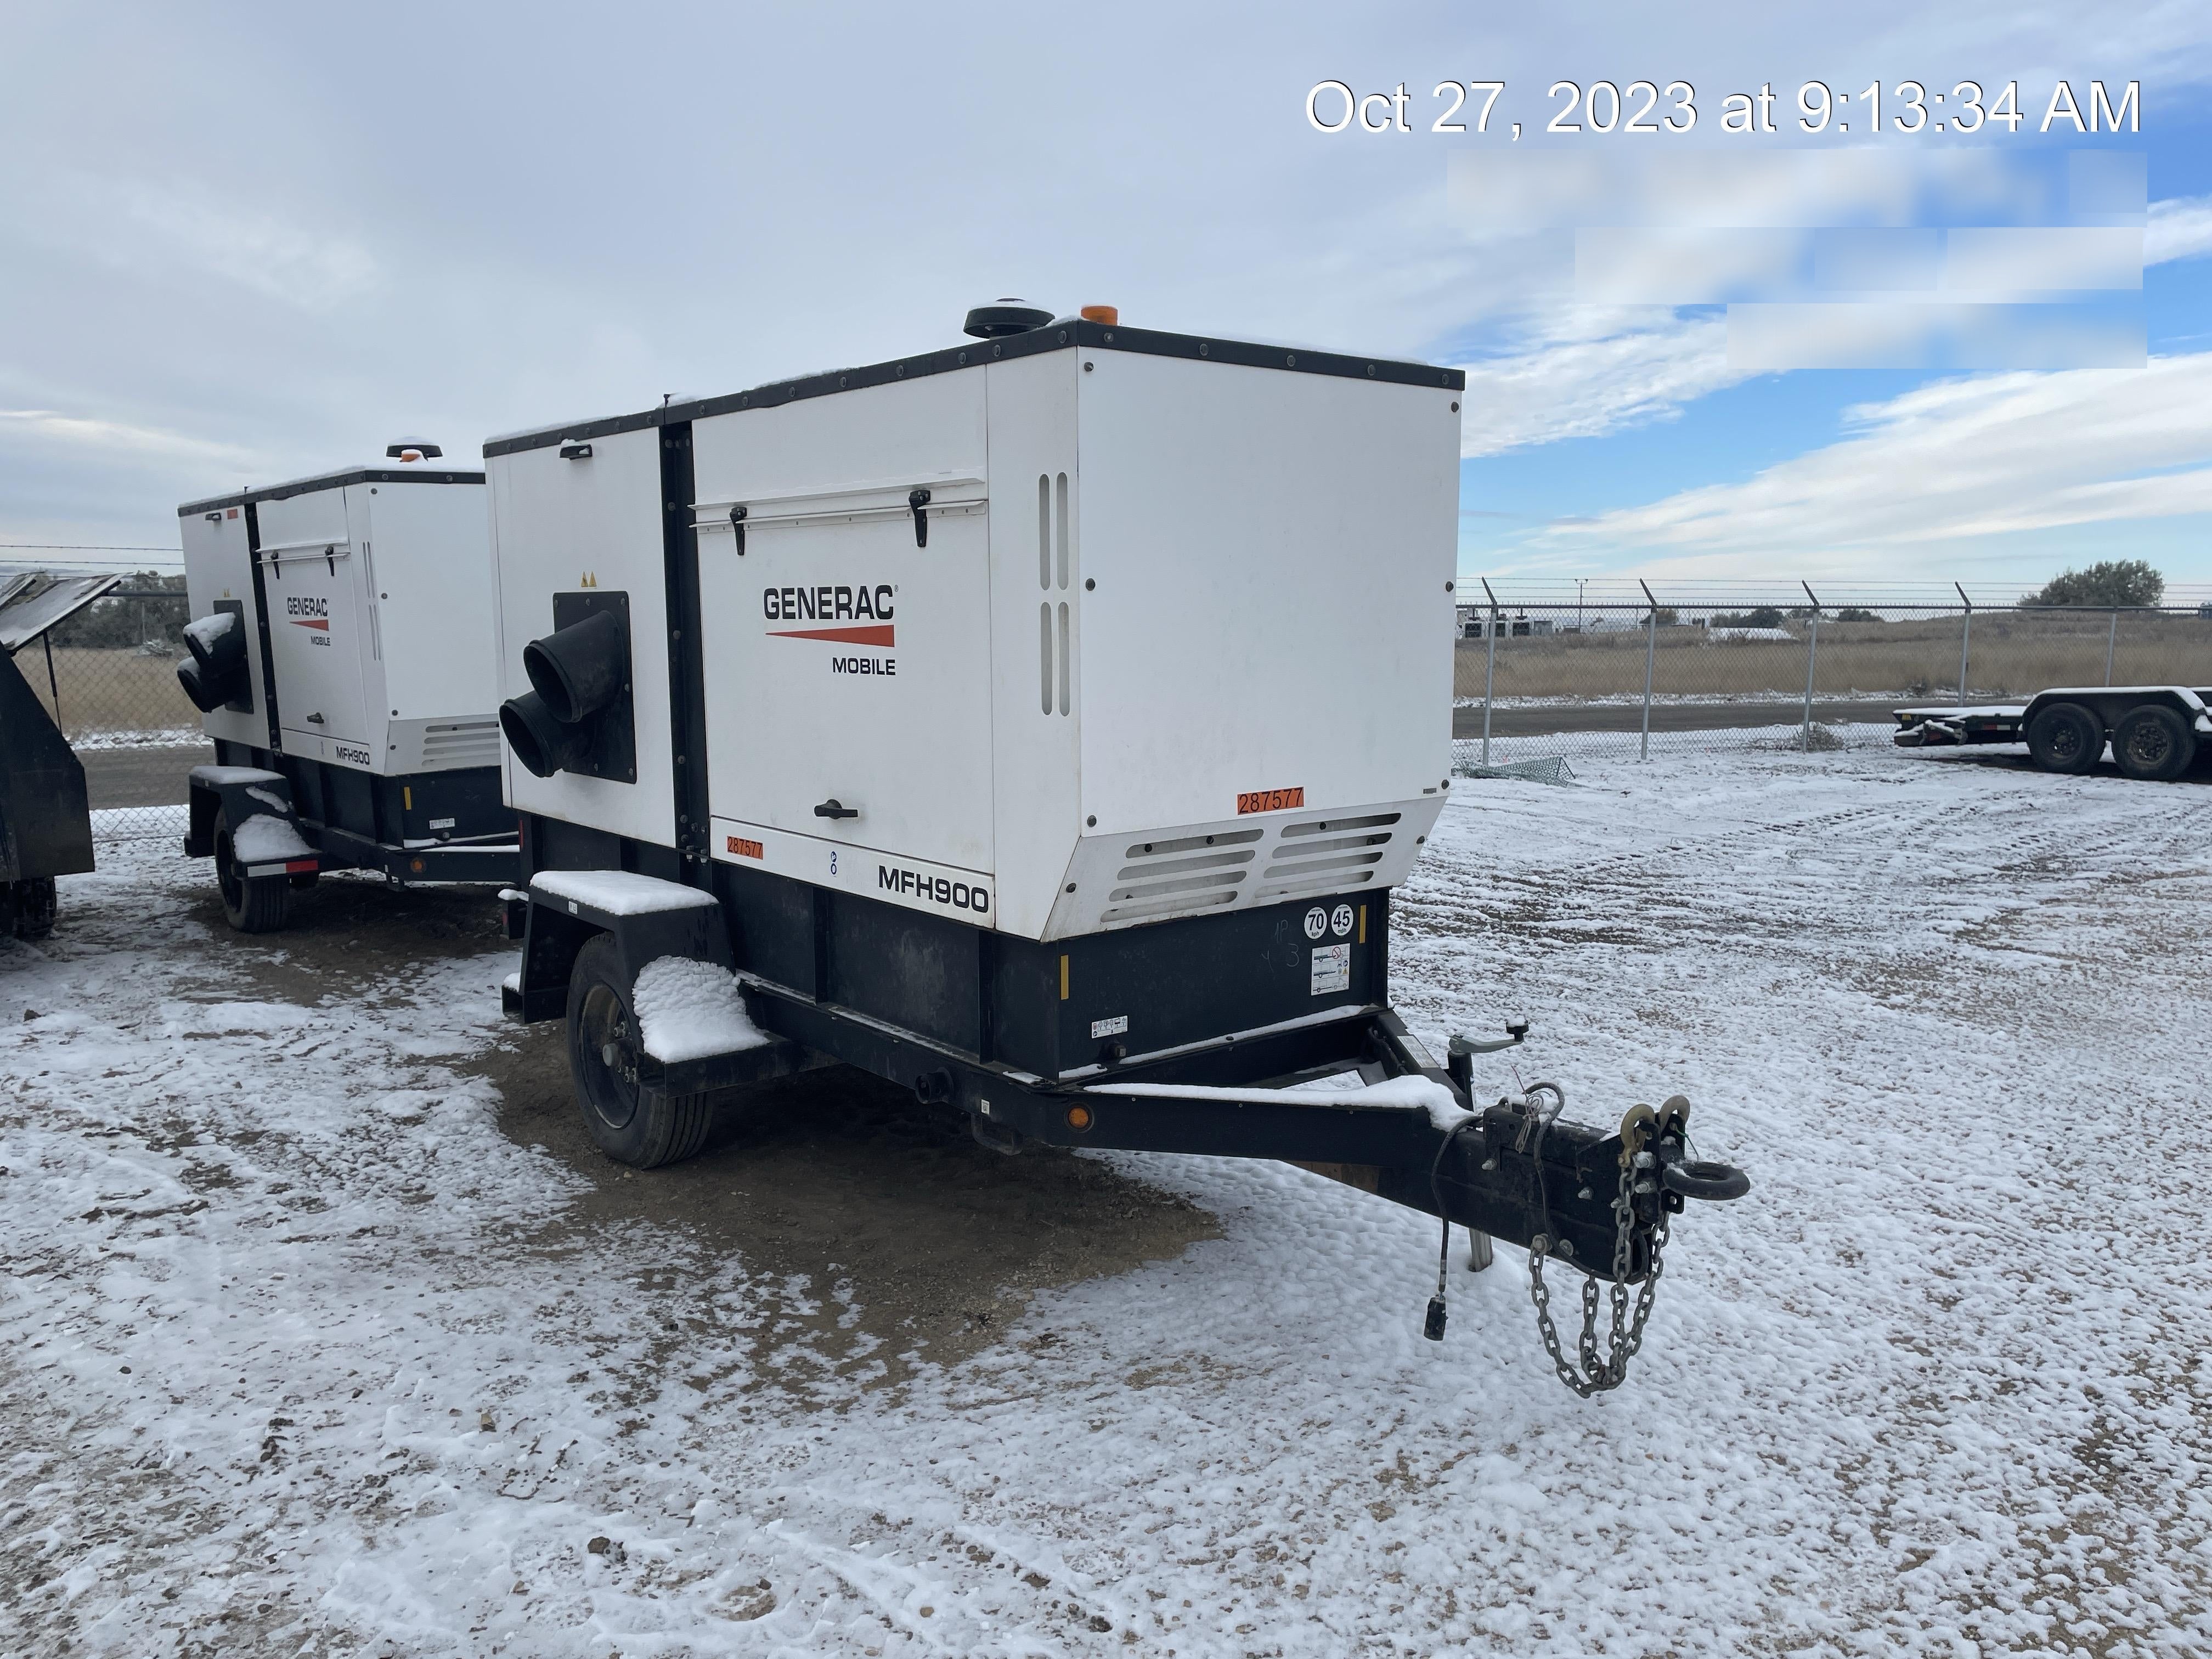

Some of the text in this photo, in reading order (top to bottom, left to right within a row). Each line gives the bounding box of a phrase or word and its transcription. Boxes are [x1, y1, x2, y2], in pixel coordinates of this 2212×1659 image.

[287, 597, 328, 617] GENERAC
[764, 584, 894, 620] GENERAC
[311, 636, 331, 647] MOBILE
[832, 657, 896, 676] MOBILE
[336, 746, 370, 765] MFH900
[1239, 787, 1304, 814] 287577
[727, 836, 763, 858] 287577
[879, 865, 989, 913] MFH900
[1308, 913, 1324, 931] 70
[1333, 910, 1350, 928] 45
